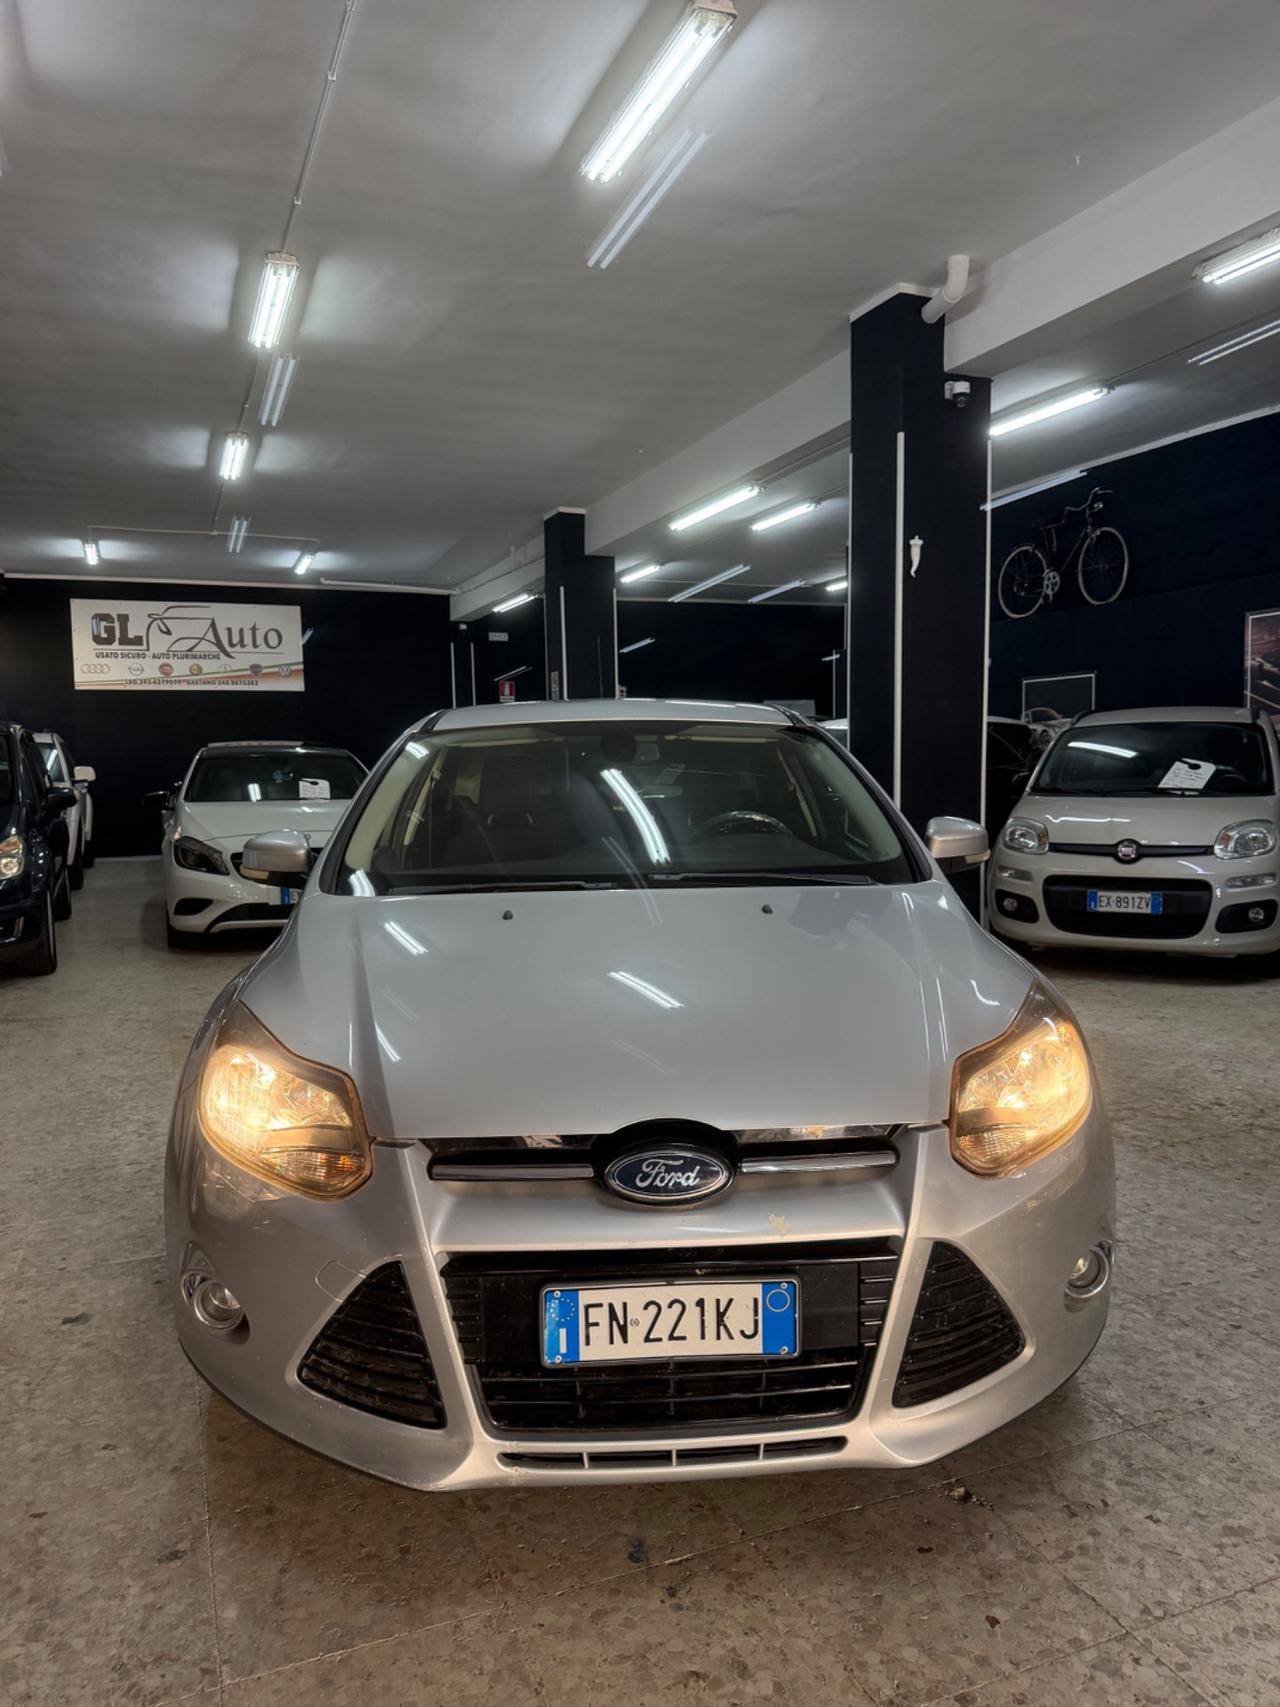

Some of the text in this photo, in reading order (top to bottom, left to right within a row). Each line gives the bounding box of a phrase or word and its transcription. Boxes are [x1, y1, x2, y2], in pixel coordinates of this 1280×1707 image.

[91, 612, 284, 659] GL Auto
[95, 651, 119, 659] USATO
[120, 652, 147, 660] SICURO
[152, 652, 171, 660] AUTO
[172, 653, 221, 661] PLURIMARCHE
[635, 1159, 700, 1188] Ford
